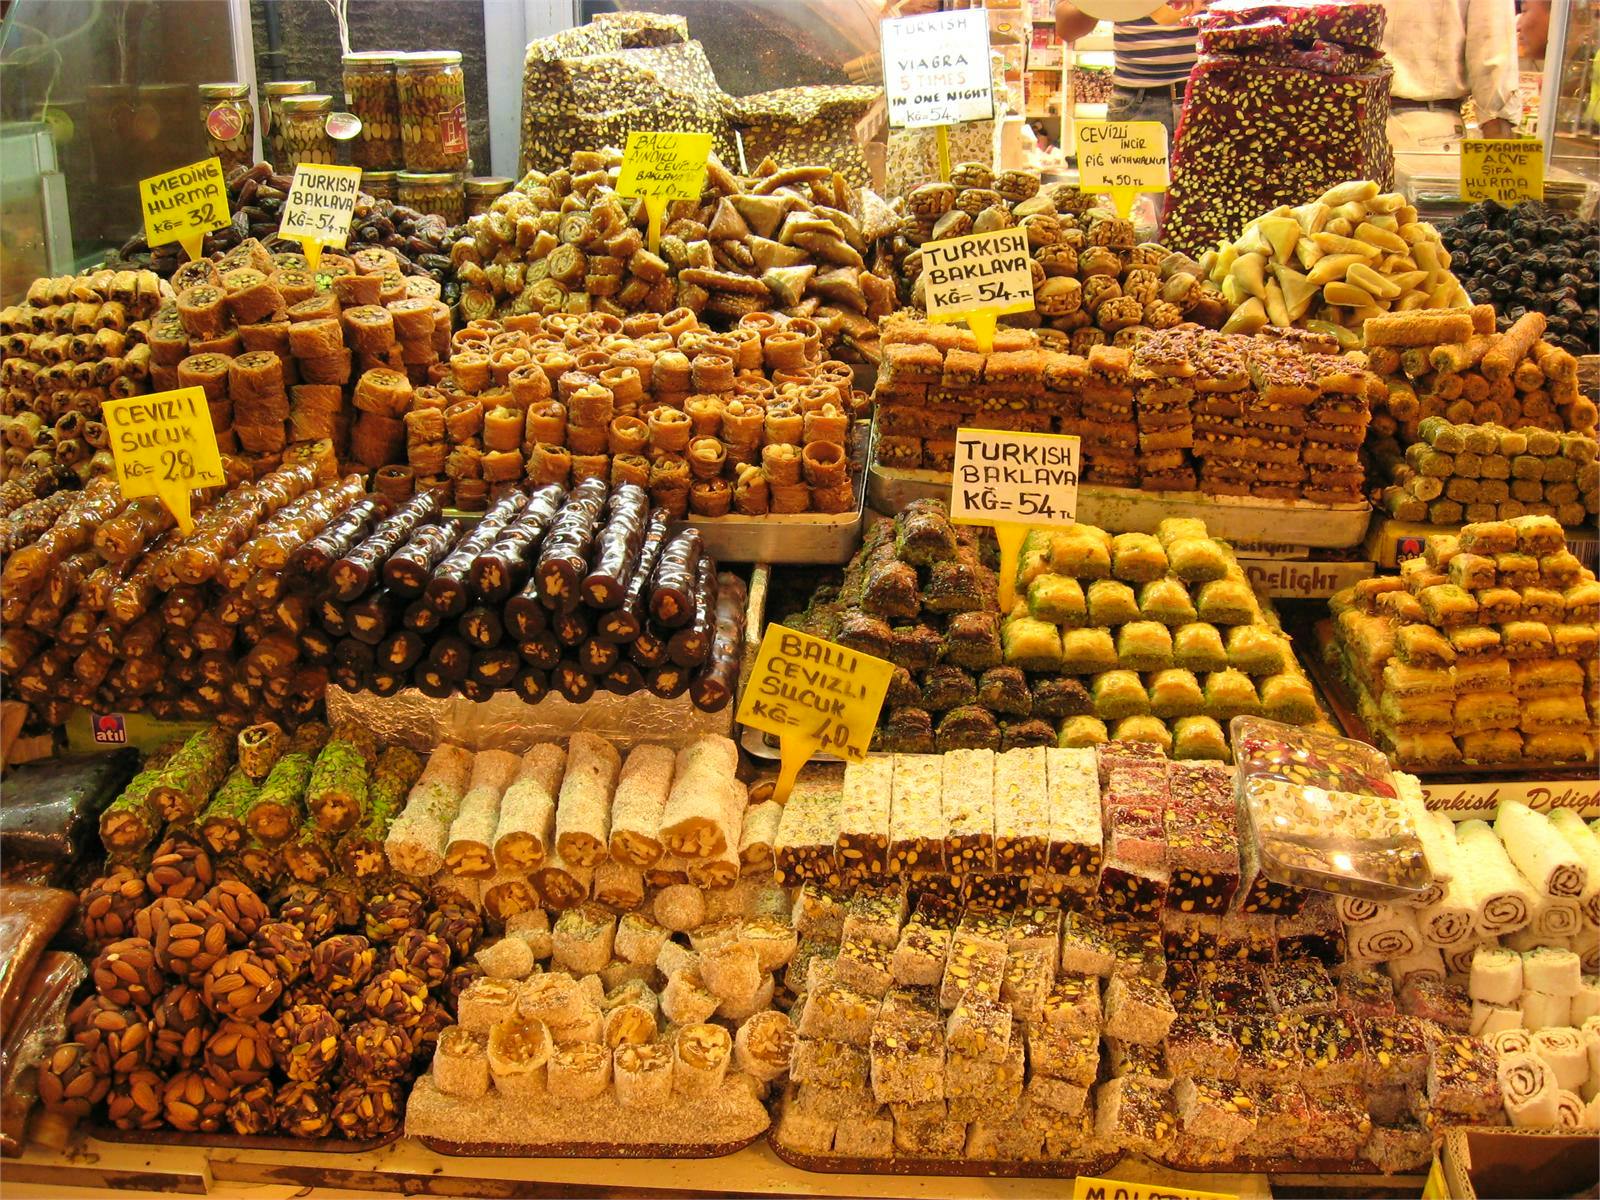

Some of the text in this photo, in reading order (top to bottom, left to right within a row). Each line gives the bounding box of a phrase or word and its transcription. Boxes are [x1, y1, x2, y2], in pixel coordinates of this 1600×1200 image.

[893, 18, 967, 36] TURKISH
[898, 54, 968, 71] VIAGRA
[900, 71, 966, 91] 5 TIMES
[893, 88, 989, 106] IN ONE NIGHT
[1463, 142, 1543, 154] PEYGAMBER
[1483, 153, 1528, 165] ACVE
[298, 173, 356, 194] TURKISH
[651, 183, 677, 200] 40
[677, 190, 690, 198] TL
[1116, 175, 1131, 185] 50
[1465, 177, 1528, 189] HURMA
[147, 184, 219, 215] HURMA
[292, 191, 354, 212] BAKLAVA
[187, 203, 216, 227] 32
[923, 235, 1026, 266] TURKISH
[929, 257, 1027, 285] BAKLAVA
[958, 440, 1071, 466] TURKISH
[160, 449, 196, 481] 28
[198, 471, 219, 480] TL
[960, 464, 1077, 487] BAKLAVA
[1018, 492, 1056, 519] 54
[1059, 510, 1075, 520] TL
[780, 633, 858, 674] BALLI
[767, 656, 867, 700] CEVIZLI
[759, 676, 846, 718] SUCUK
[810, 718, 850, 749] 40
[847, 744, 864, 760] TL
